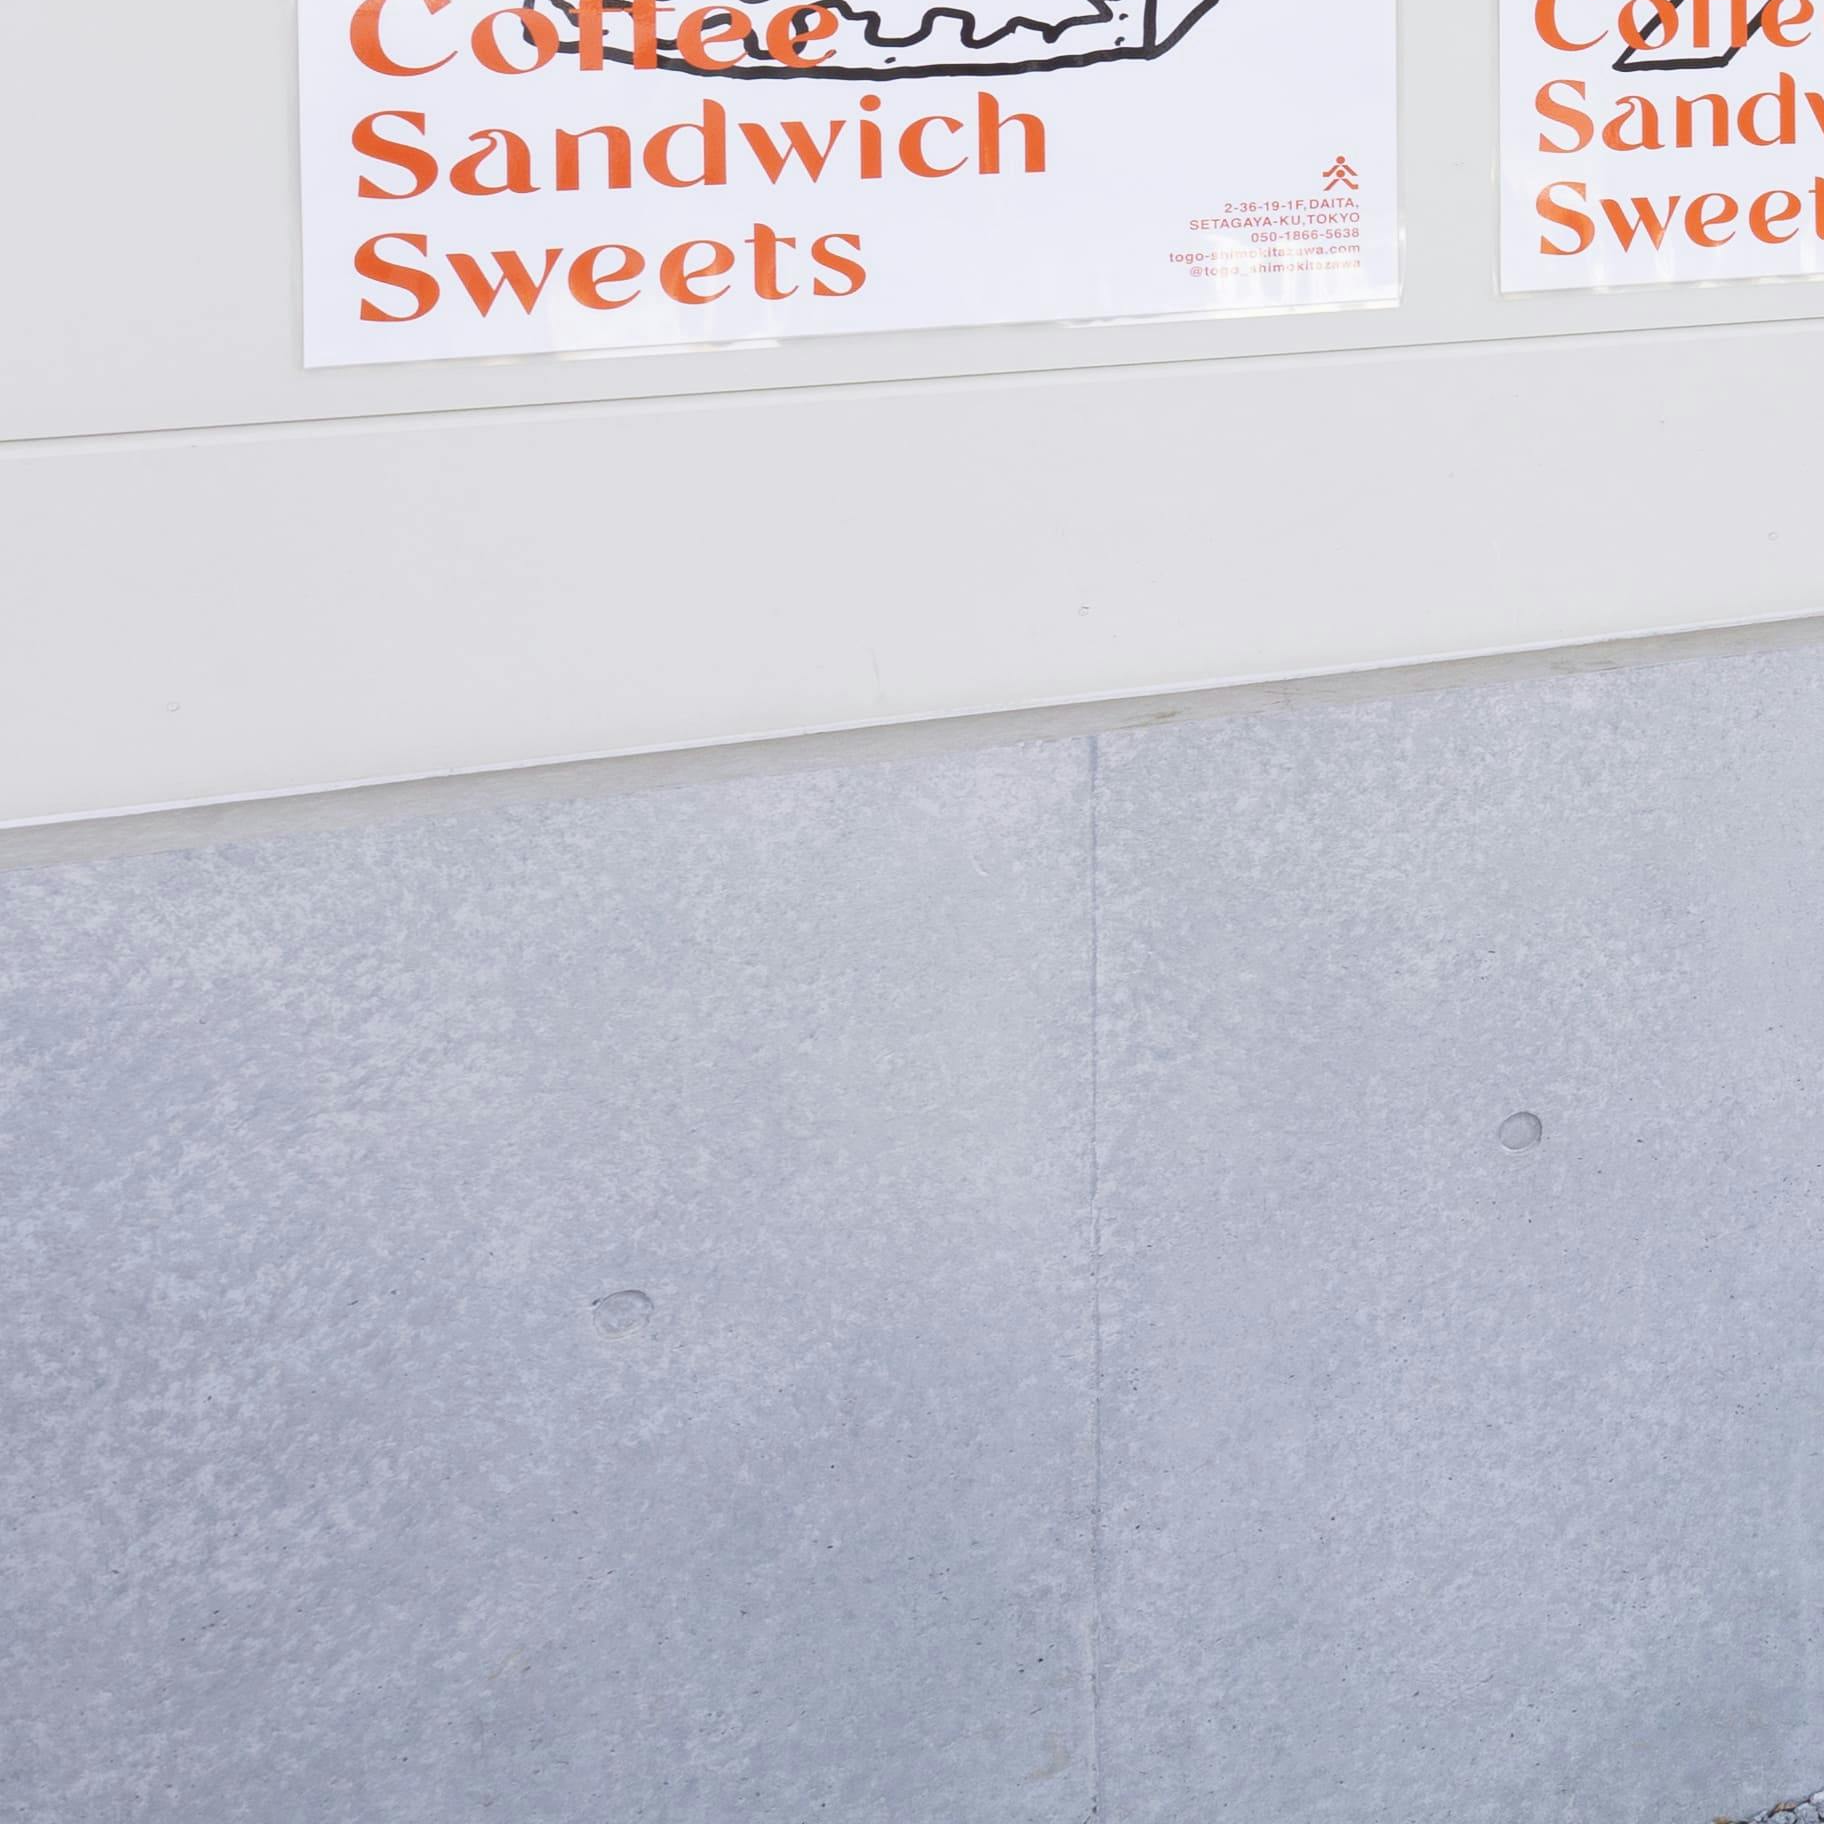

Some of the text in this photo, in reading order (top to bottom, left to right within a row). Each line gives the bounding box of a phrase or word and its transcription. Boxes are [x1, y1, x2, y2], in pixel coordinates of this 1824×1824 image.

[350, 92, 1048, 200] Sandwich
[352, 222, 868, 324] Sweets
[1251, 228, 1360, 243] 050-1866-5638
